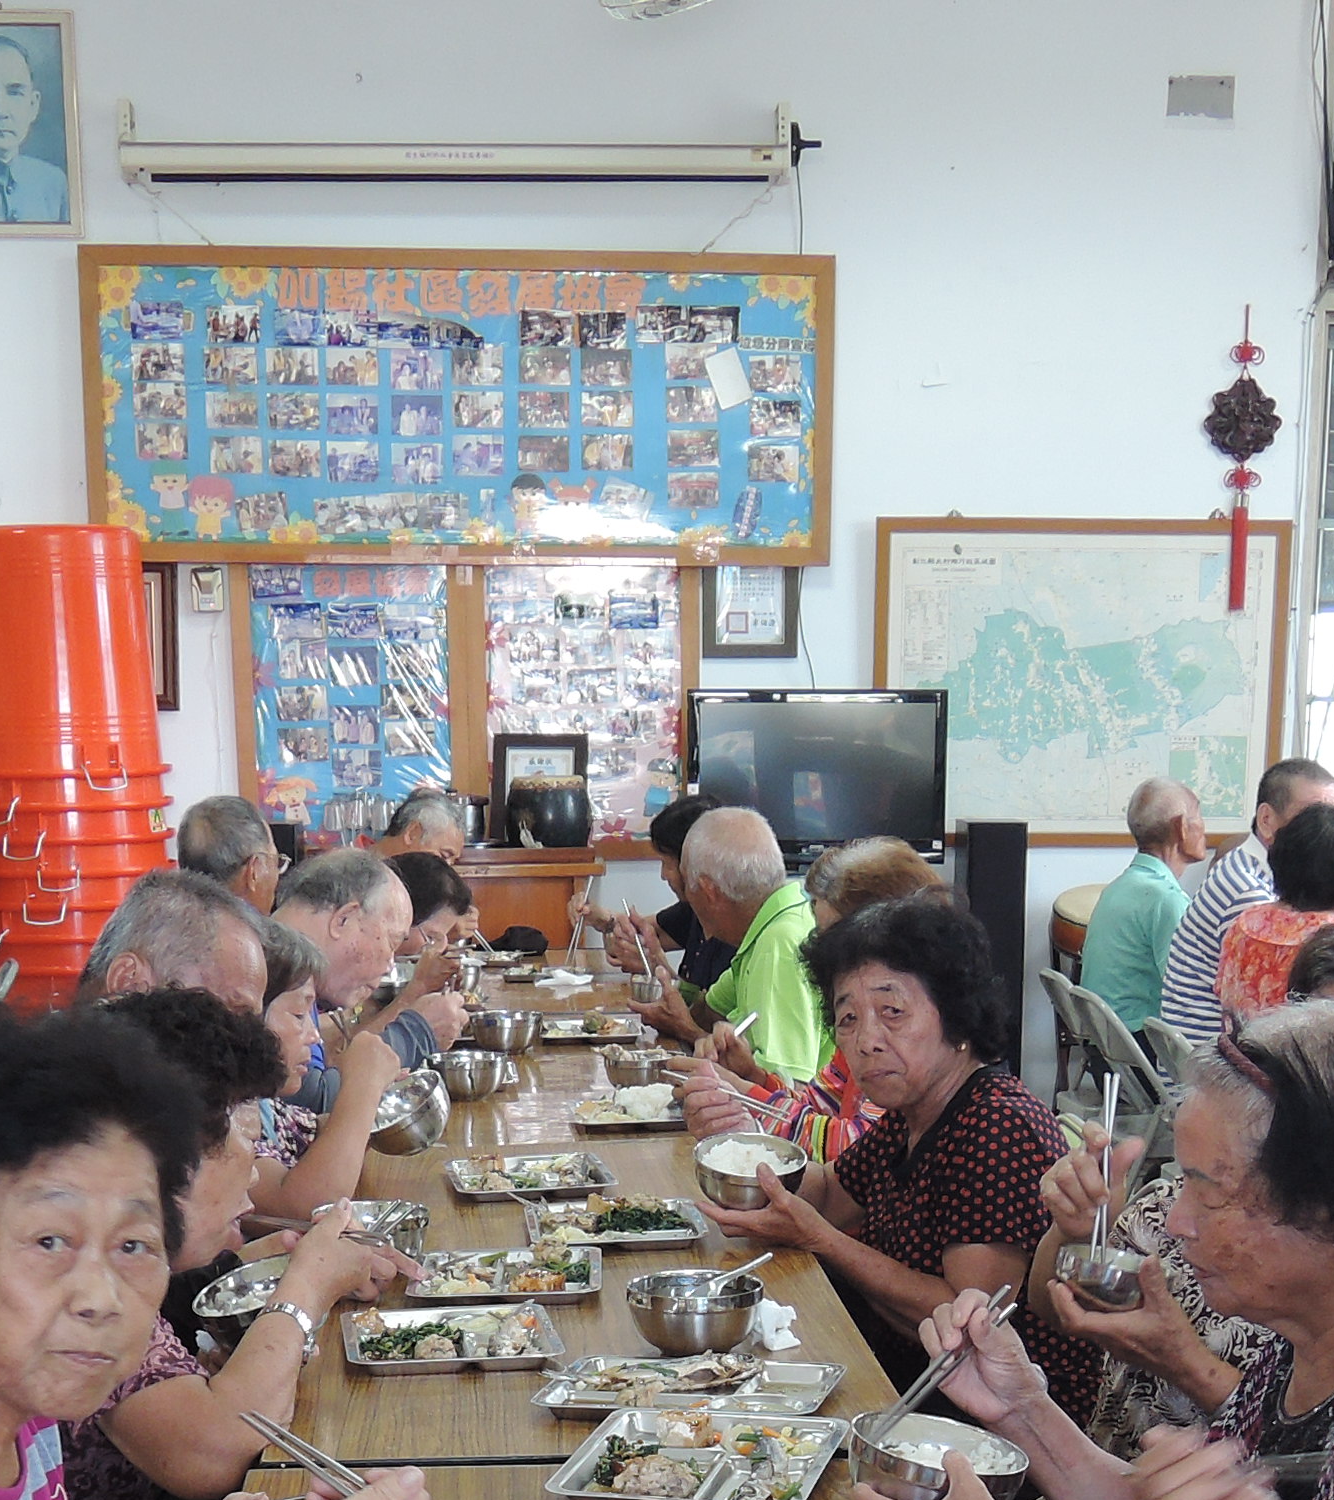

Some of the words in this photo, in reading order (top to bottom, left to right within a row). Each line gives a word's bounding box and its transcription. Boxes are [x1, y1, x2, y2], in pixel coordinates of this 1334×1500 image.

[276, 268, 647, 318] 加錫社區發展協會
